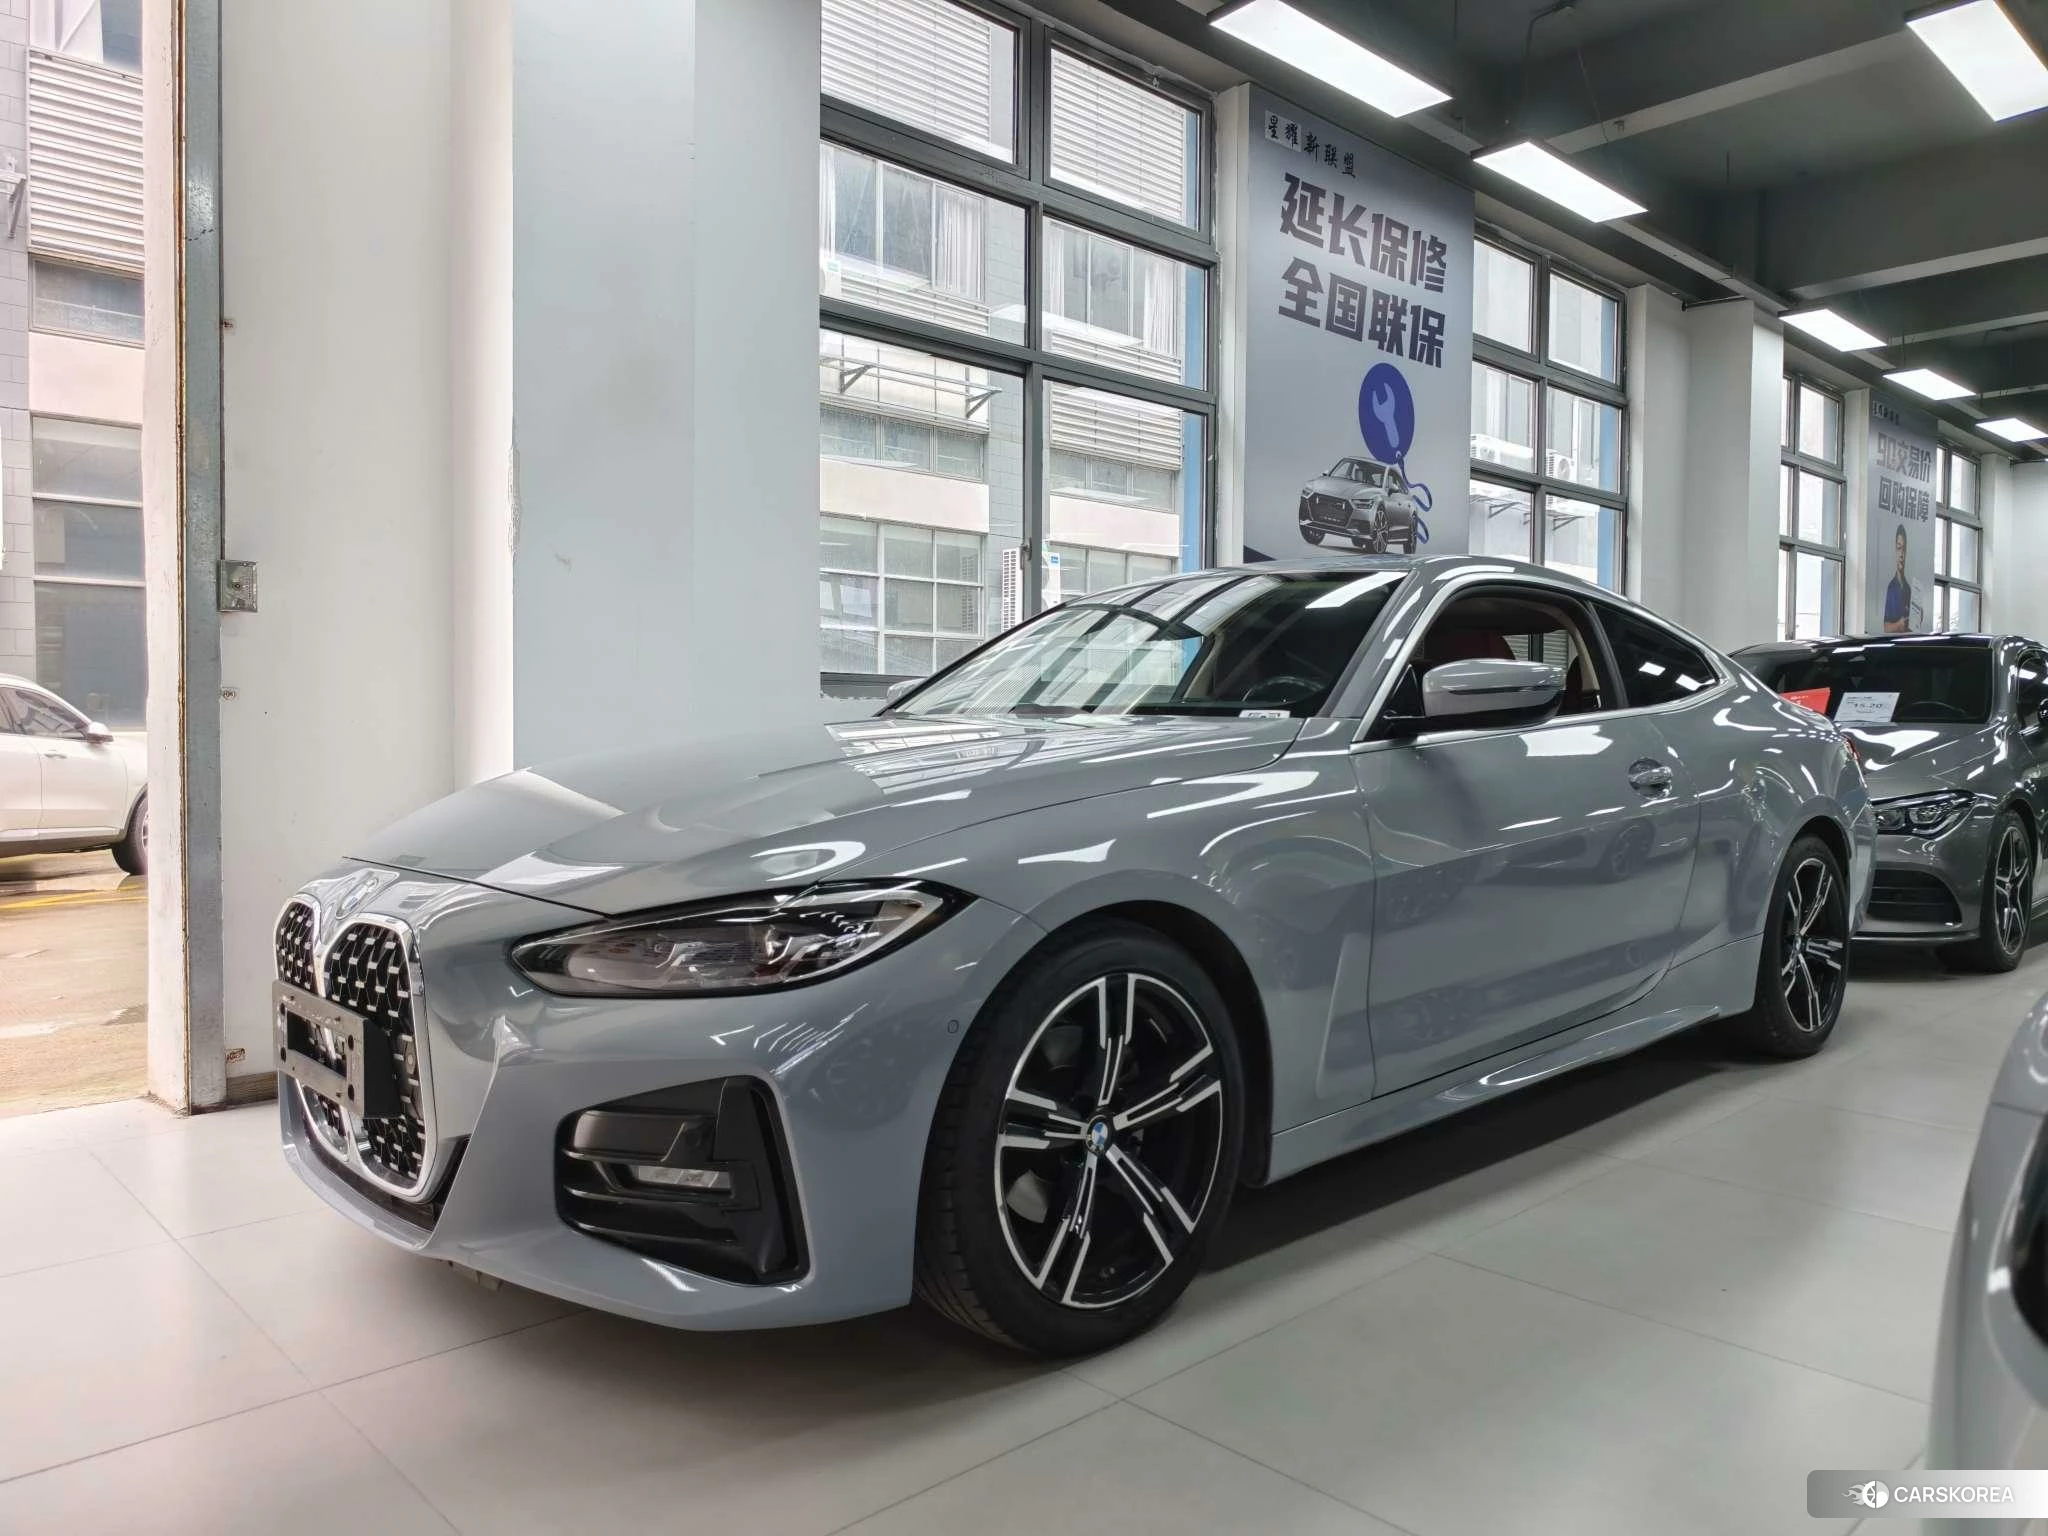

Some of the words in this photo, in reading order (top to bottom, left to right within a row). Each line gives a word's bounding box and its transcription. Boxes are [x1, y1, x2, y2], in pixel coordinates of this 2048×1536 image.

[1268, 115, 1356, 178] 星耀新联盟
[1280, 172, 1447, 293] 延长保修
[1278, 257, 1446, 368] 全国联保
[1879, 476, 1930, 522] 回购保障
